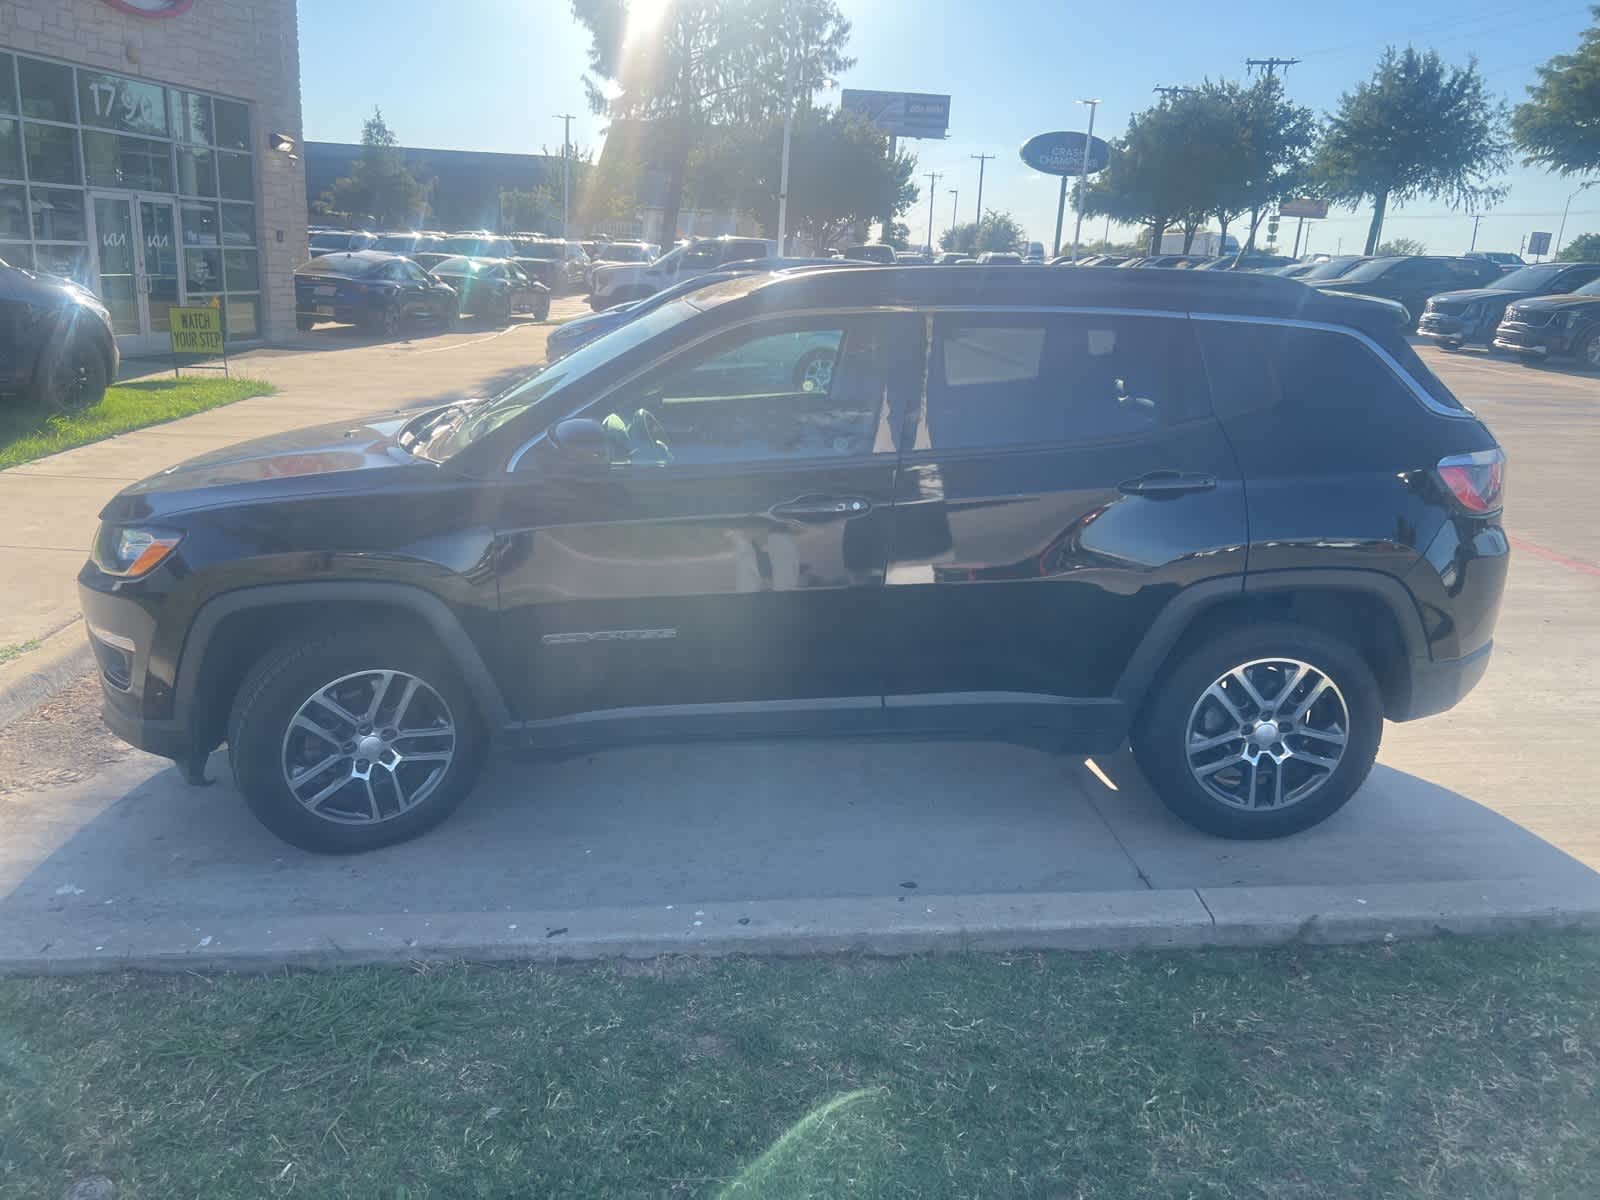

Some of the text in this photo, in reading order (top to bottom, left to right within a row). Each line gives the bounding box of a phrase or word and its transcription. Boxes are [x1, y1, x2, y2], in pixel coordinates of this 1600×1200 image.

[181, 313, 210, 329] WATCH
[174, 331, 222, 348] YOUR STEP
